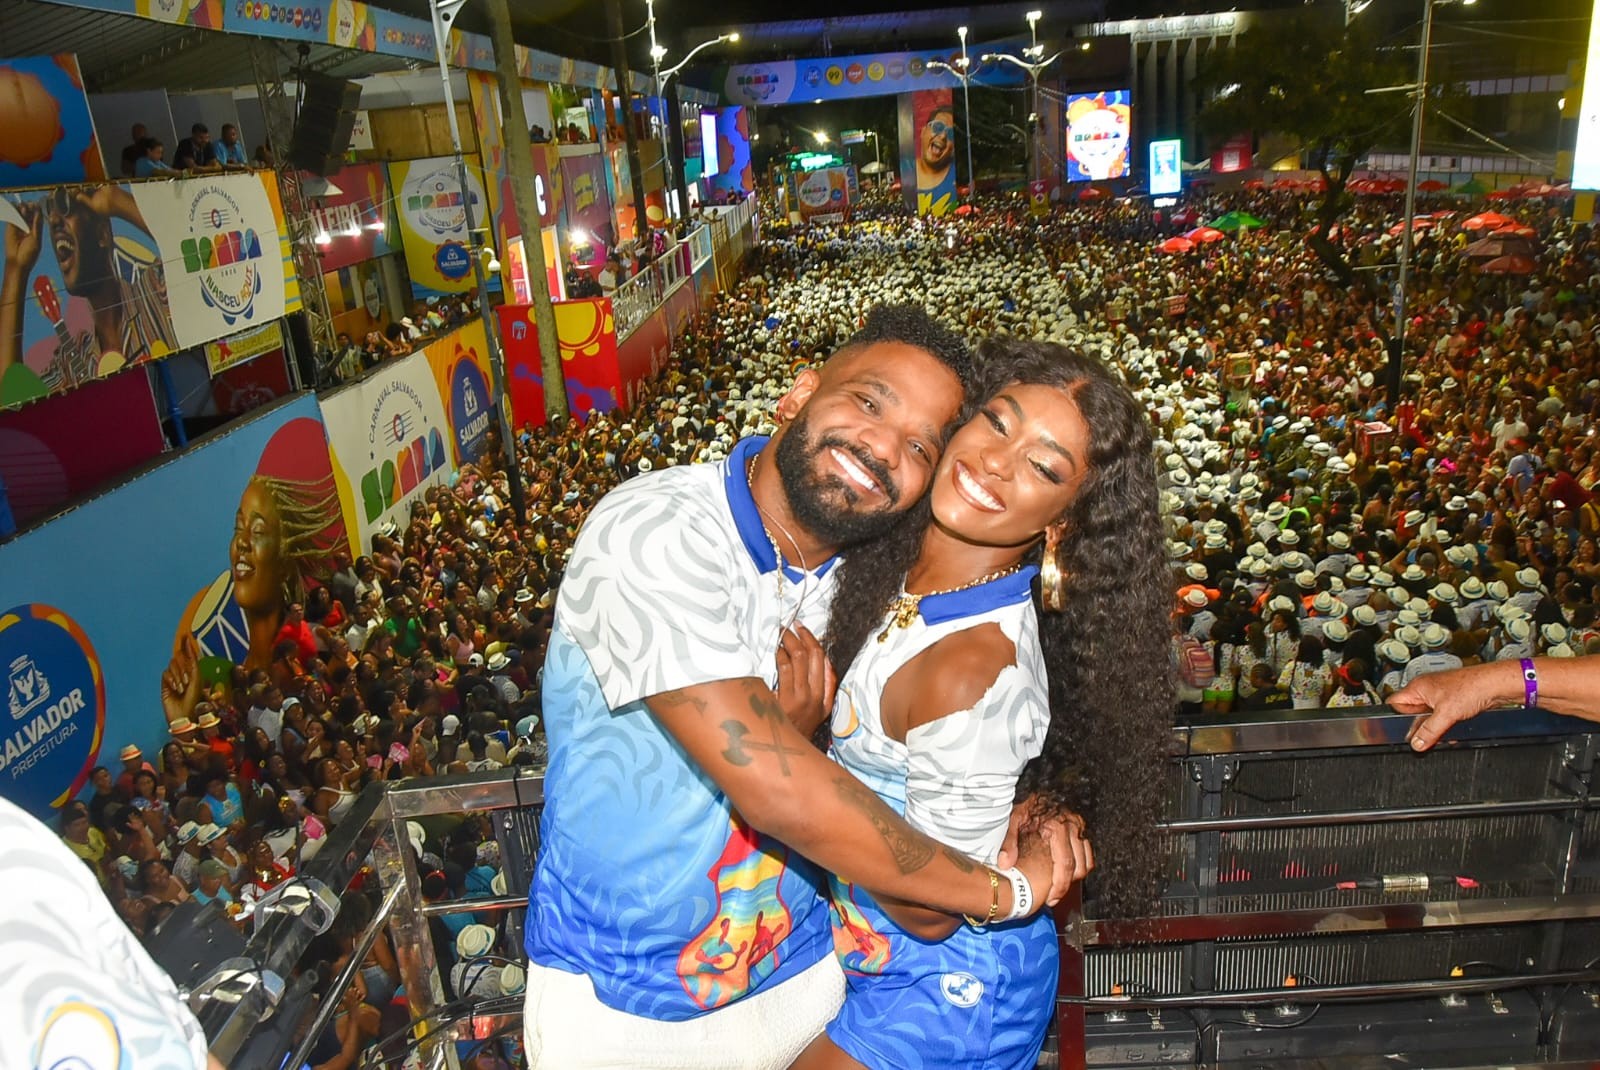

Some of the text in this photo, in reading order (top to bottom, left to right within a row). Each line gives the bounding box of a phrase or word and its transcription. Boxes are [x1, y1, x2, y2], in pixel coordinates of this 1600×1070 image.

[188, 185, 241, 222] CARNAVAL SALVADOR
[206, 273, 241, 308] NASCEU
[369, 381, 423, 444] CARNAVAL SALVADOR
[459, 410, 490, 446] SALVADOR
[11, 722, 78, 780] PREFEITURA
[1016, 877, 1027, 908] TRIO
